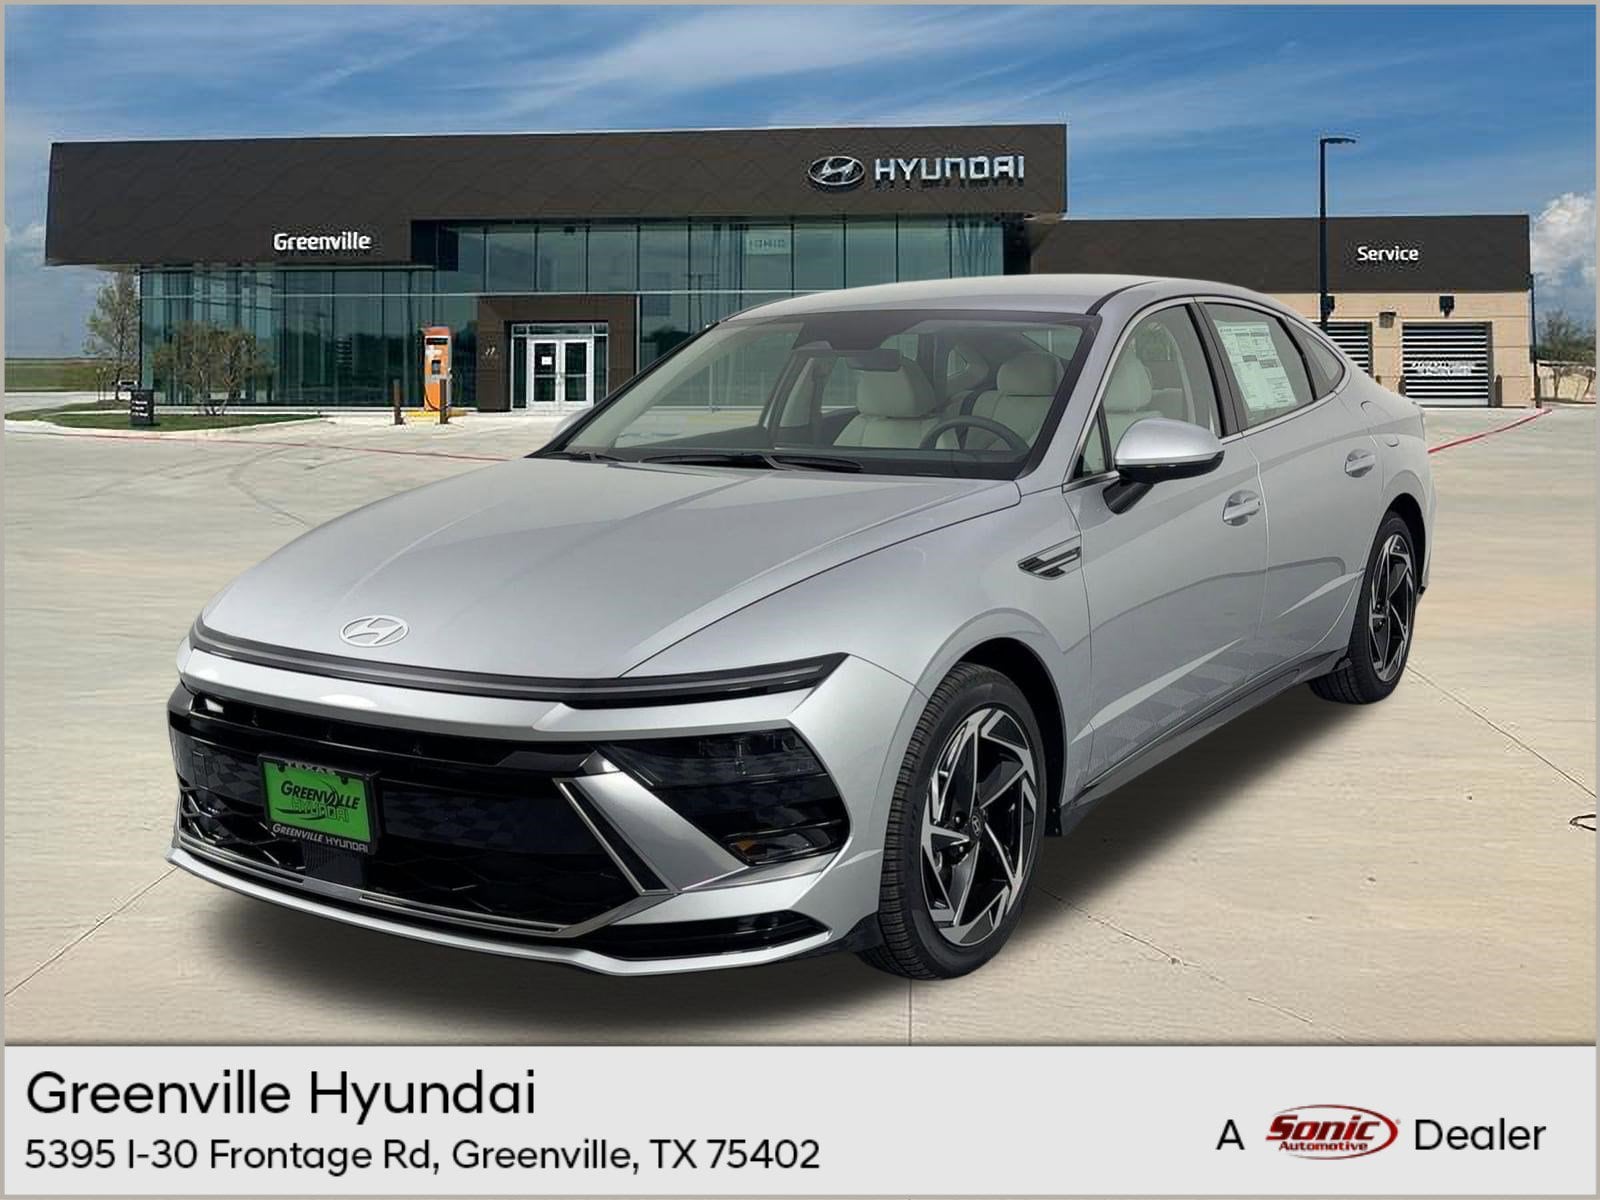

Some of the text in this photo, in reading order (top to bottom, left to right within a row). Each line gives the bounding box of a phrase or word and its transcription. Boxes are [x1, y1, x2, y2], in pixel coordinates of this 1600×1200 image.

[874, 155, 1025, 181] HYUNDAI
[273, 231, 371, 251] Greenville
[1357, 245, 1419, 261] Service
[272, 823, 369, 853] GREENVILLE HYUNDAI
